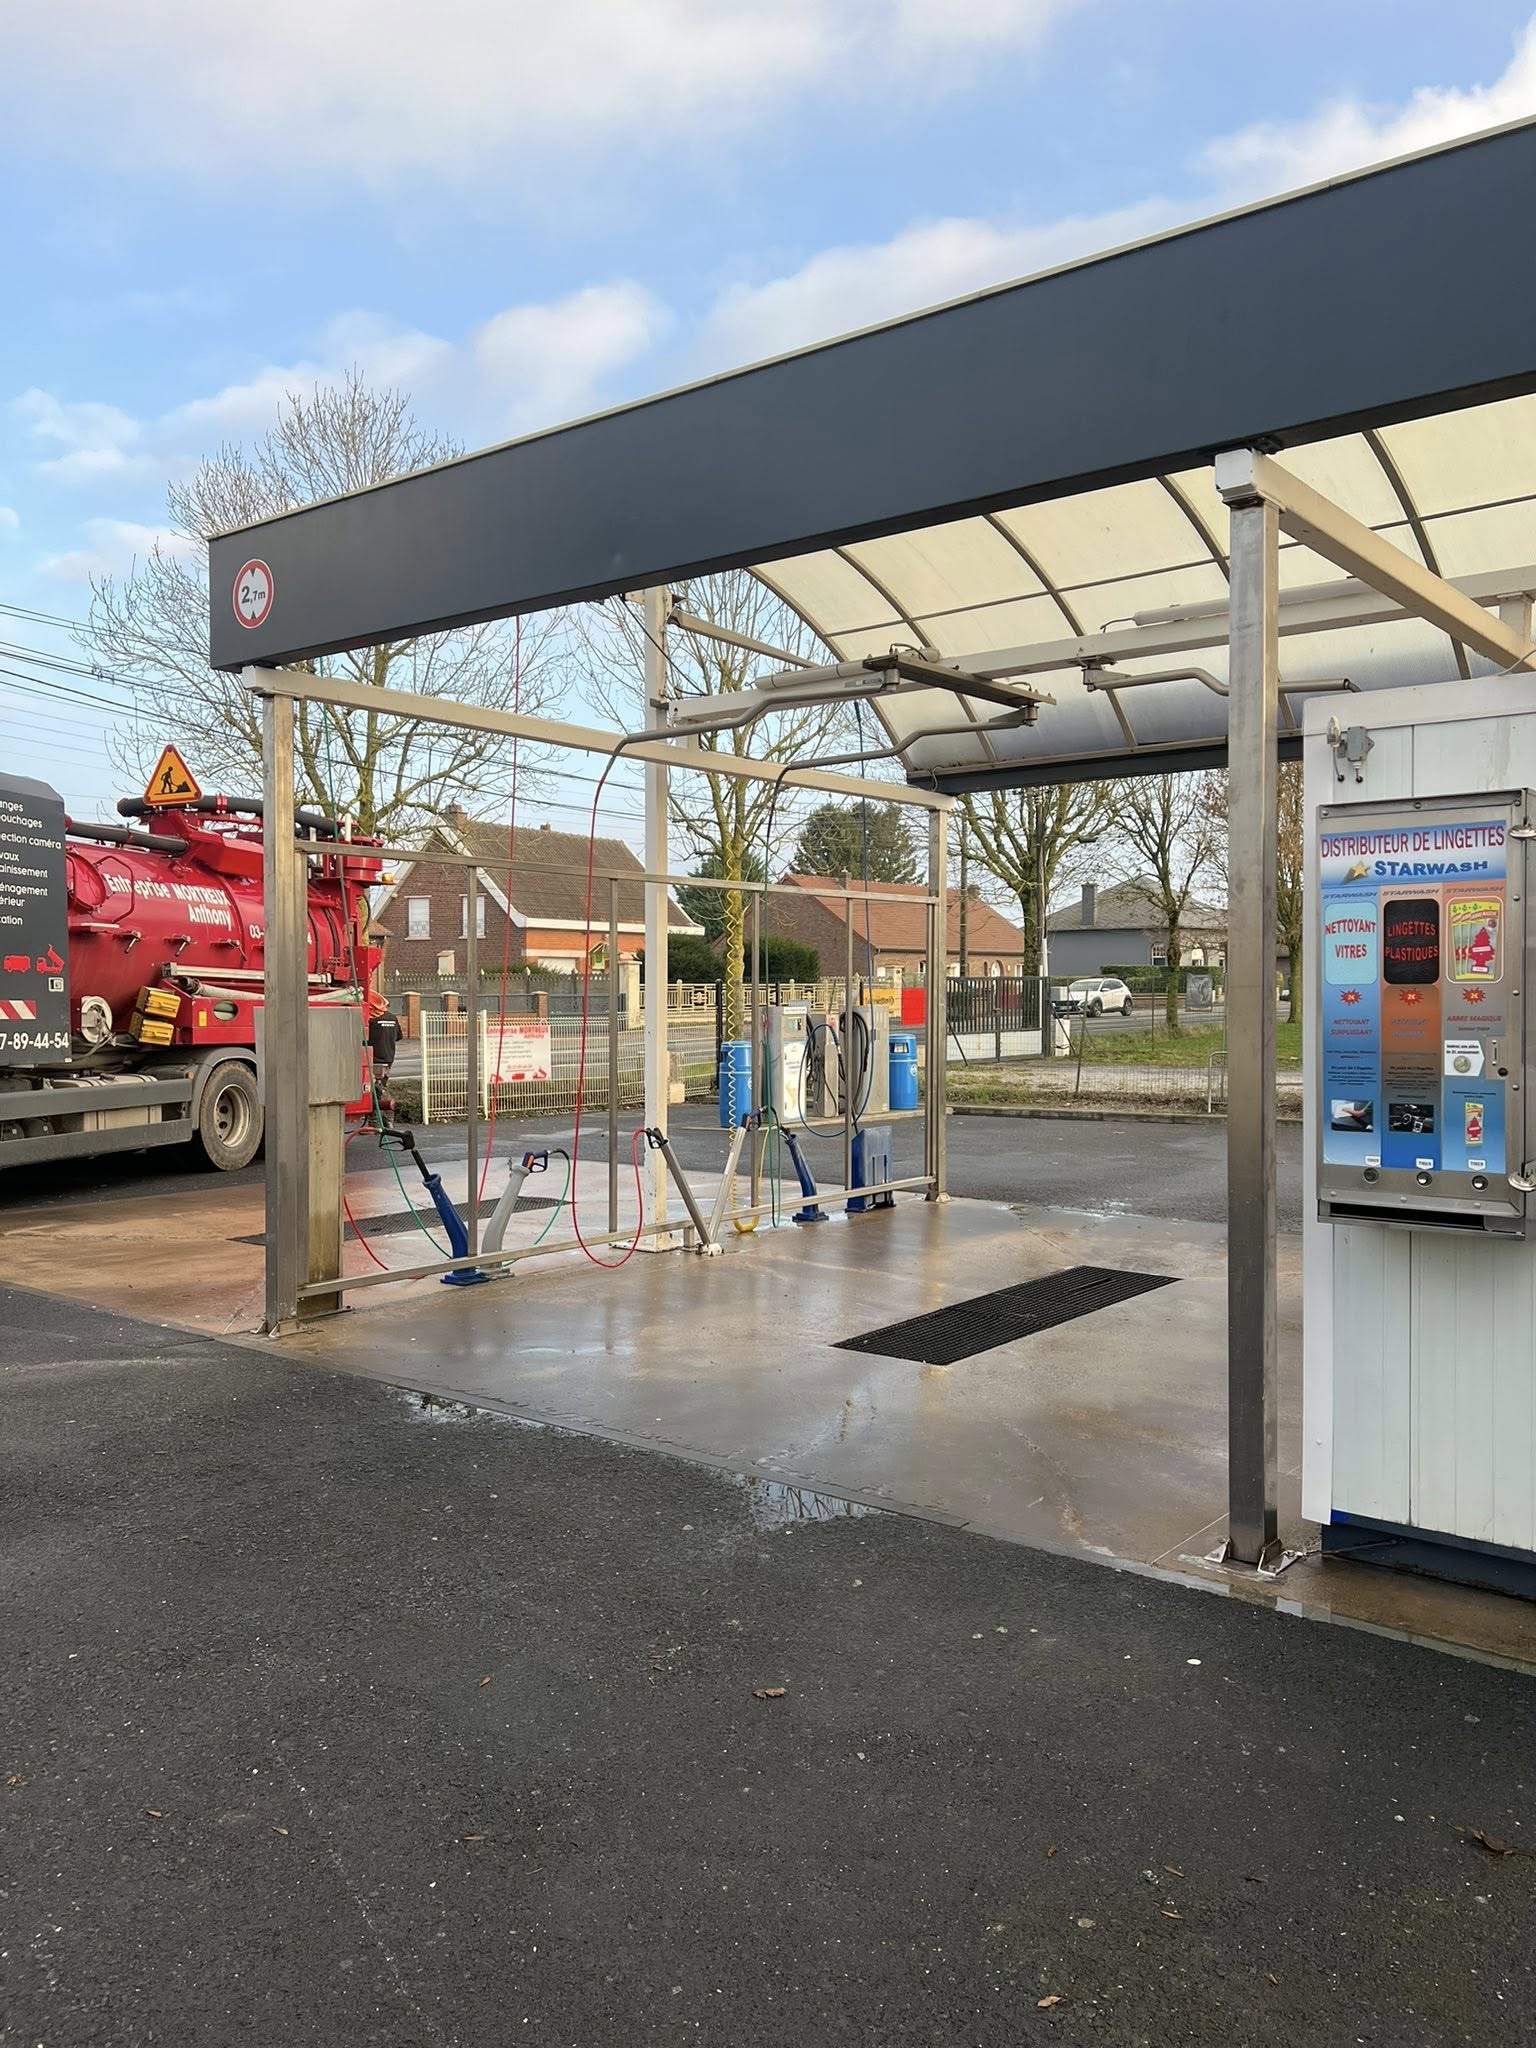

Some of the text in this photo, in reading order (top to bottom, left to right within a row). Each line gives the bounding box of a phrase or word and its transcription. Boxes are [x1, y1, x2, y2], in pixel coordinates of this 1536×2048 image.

[241, 585, 266, 604] 2,7m
[0, 814, 43, 829] ouchages
[0, 832, 62, 849] ection caméra
[1321, 825, 1505, 858] DISTRIBUTEUR DE LINGETTES
[1374, 860, 1488, 876] STARWASH
[105, 874, 231, 905] Entreprise MORTREUX
[1322, 891, 1377, 900] STARWASH
[1382, 888, 1439, 897] STARWASH
[1445, 885, 1504, 894] STARWASH
[0, 915, 23, 926] ation
[188, 904, 232, 932] Anthony
[1325, 918, 1376, 935] NETTOYANT
[1387, 920, 1437, 937] LINGETTES
[1335, 944, 1367, 959] VITRES
[1385, 945, 1439, 962] PLASTIQUES
